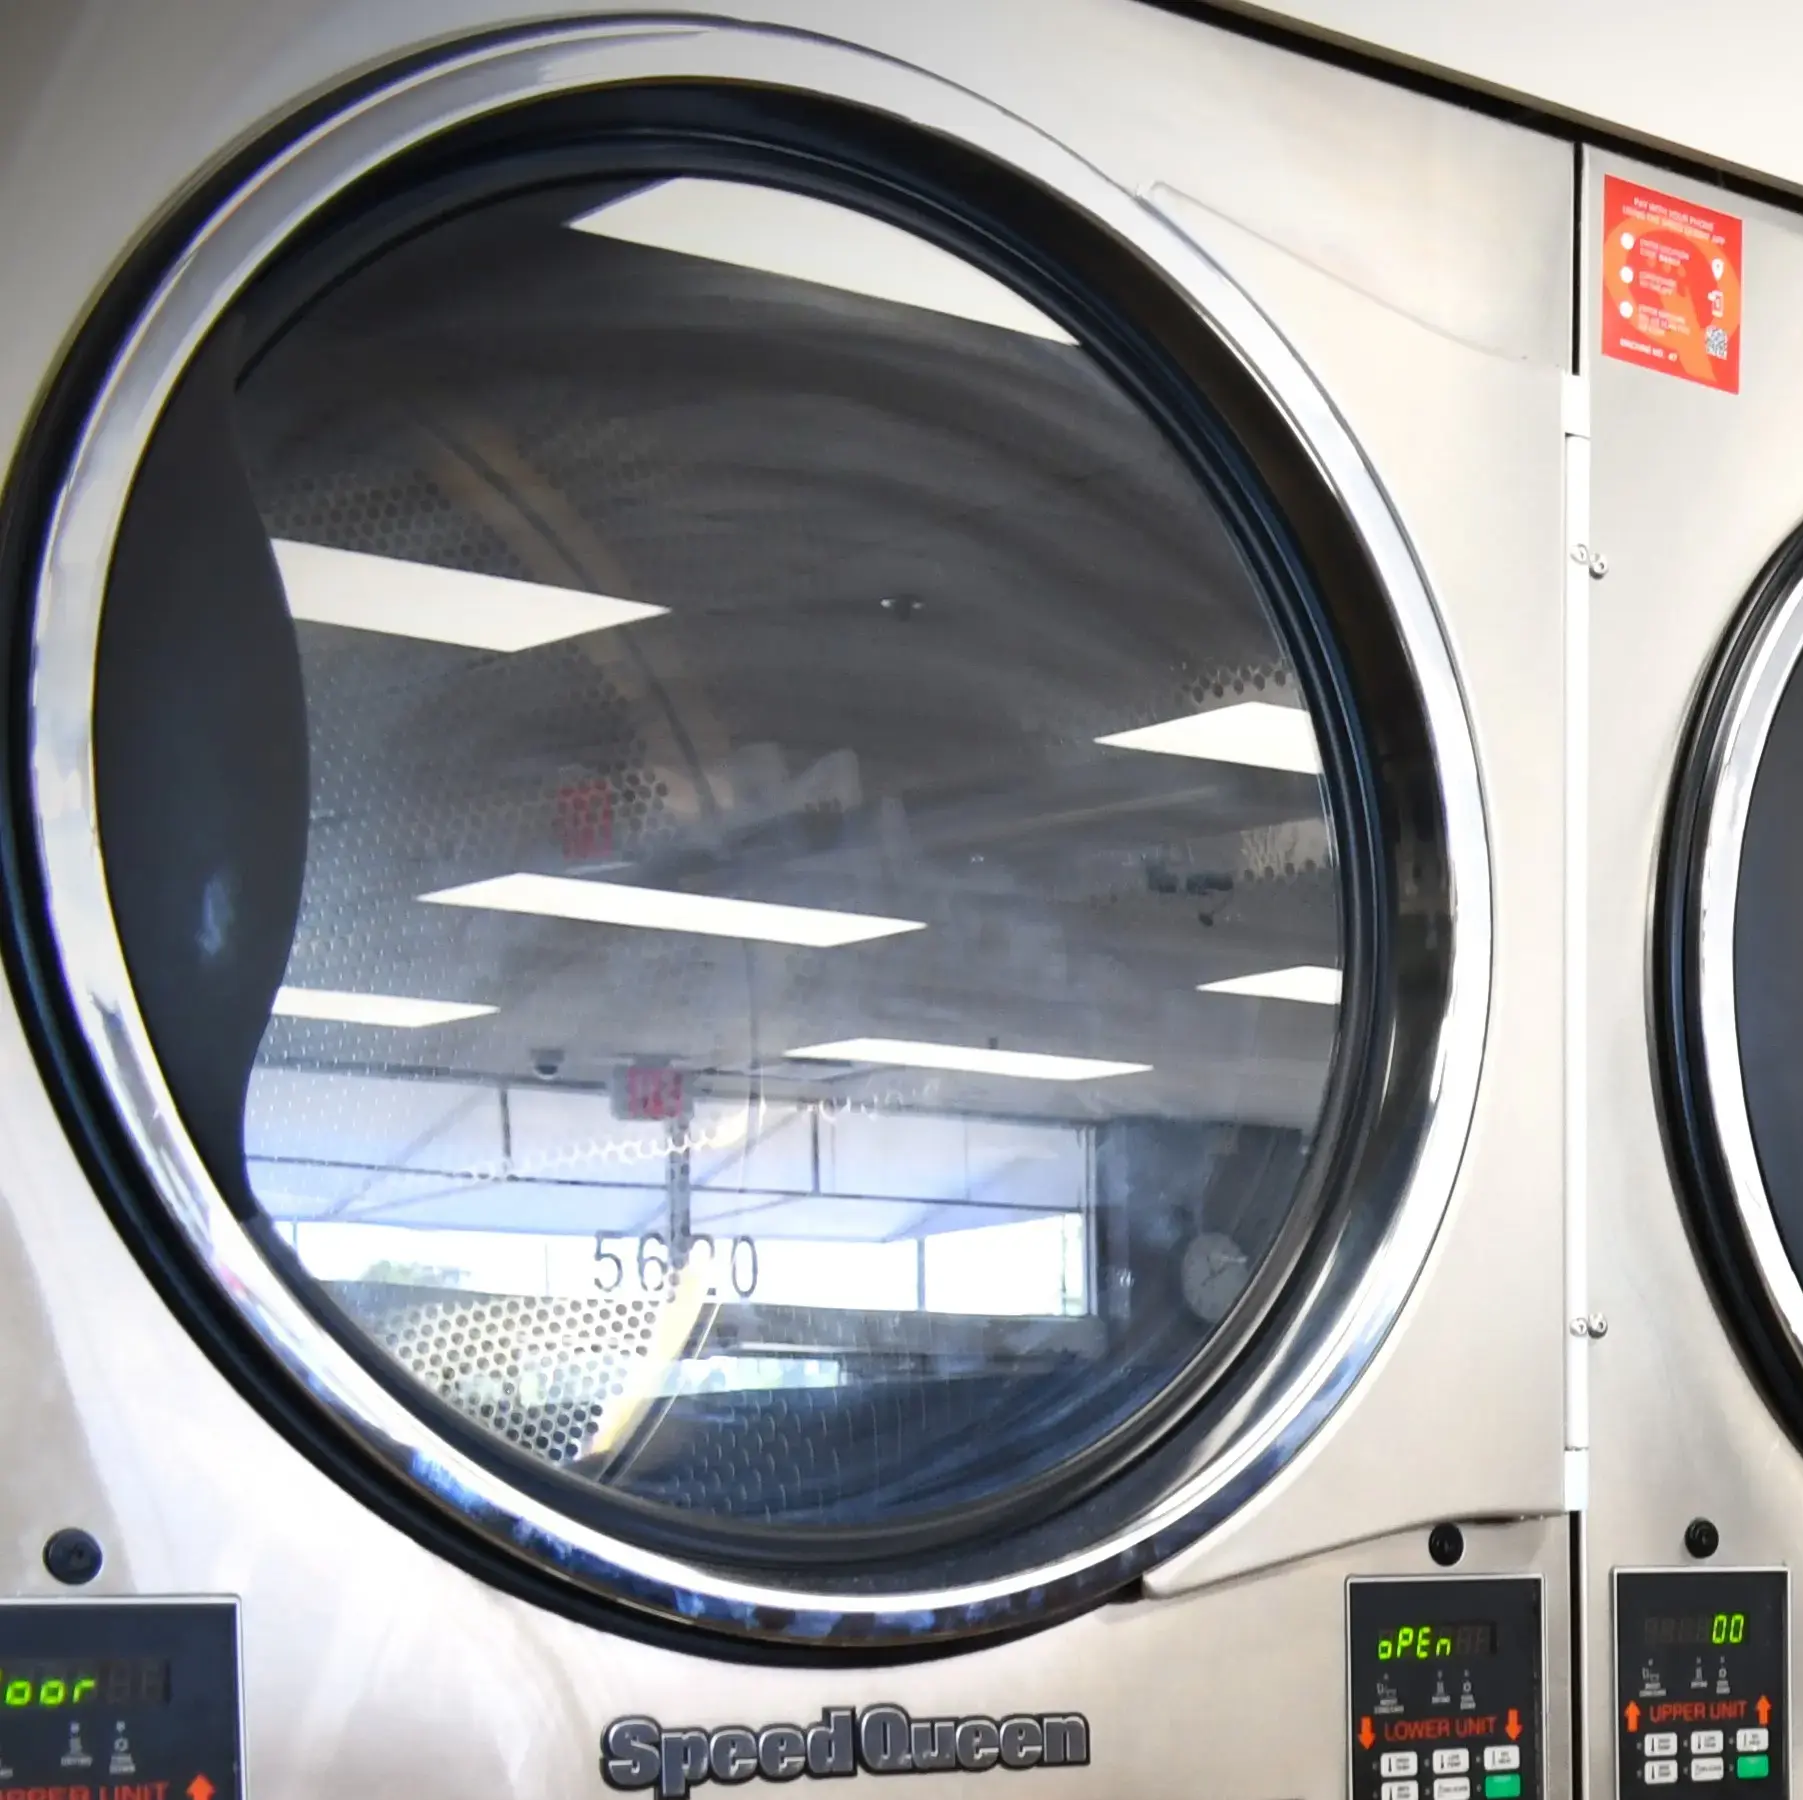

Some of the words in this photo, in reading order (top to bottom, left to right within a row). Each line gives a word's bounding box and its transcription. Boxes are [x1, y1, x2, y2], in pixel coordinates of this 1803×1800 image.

[1711, 1614, 1745, 1644] 00
[0, 1667, 95, 1706] oor
[1649, 1702, 1706, 1723] UPPER
[1709, 1700, 1748, 1721] UNIT
[1384, 1717, 1450, 1742] LOWER
[1455, 1715, 1498, 1738] UNIT
